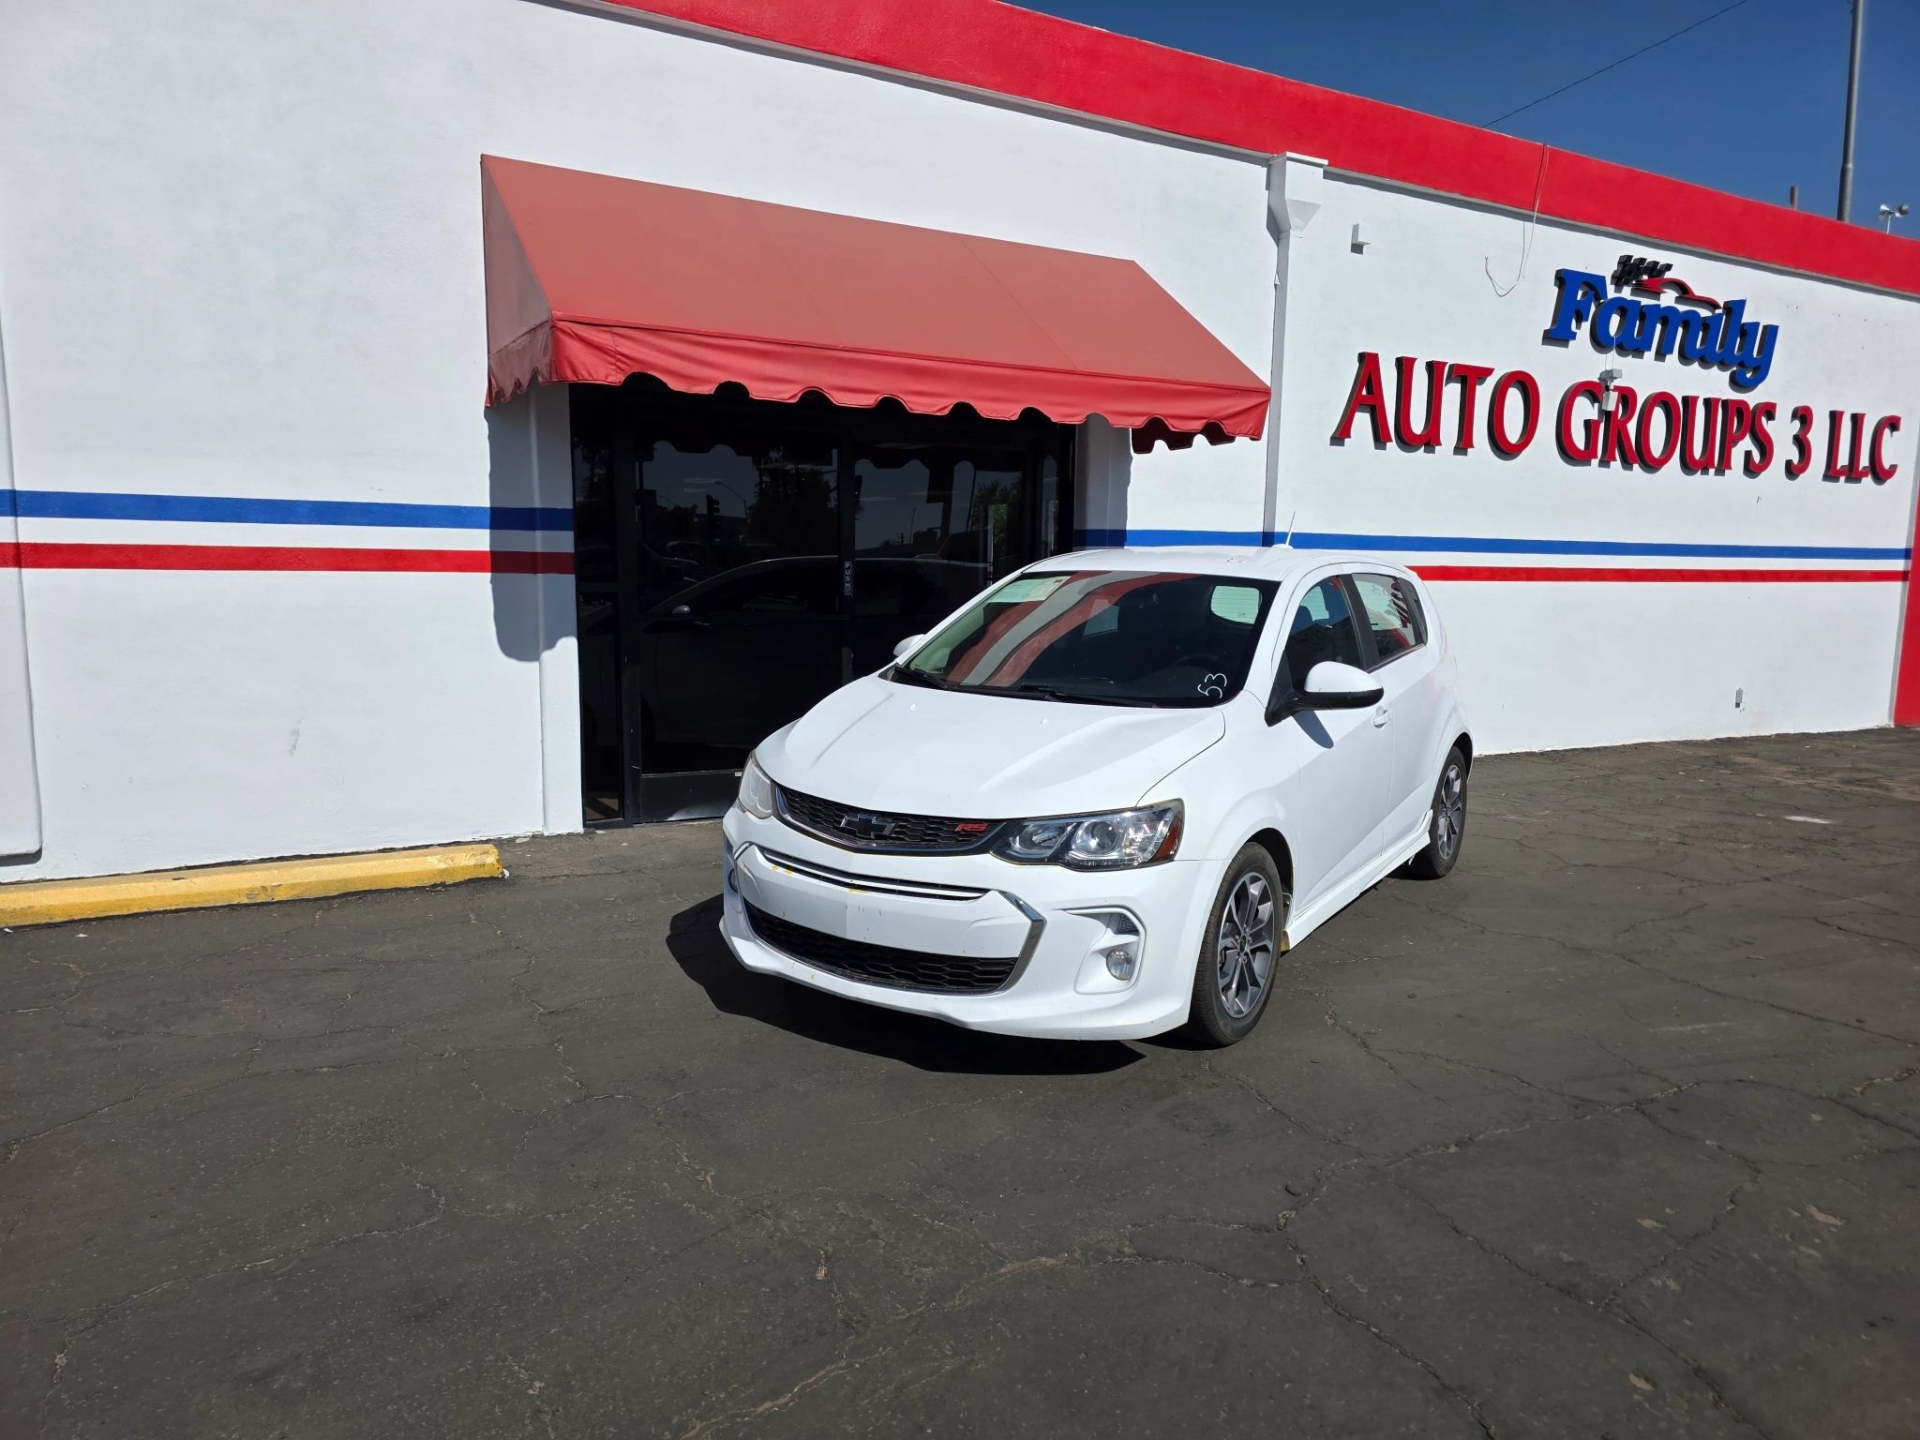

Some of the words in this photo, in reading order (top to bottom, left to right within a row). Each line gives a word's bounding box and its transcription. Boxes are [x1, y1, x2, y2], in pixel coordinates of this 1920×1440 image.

[1544, 268, 1778, 388] Family
[1332, 352, 1540, 456] AUTO
[1556, 380, 1777, 474] GROUPS
[1786, 405, 1813, 479] 3
[1825, 410, 1901, 481] LLC
[1197, 672, 1227, 699] 53
[955, 822, 987, 833] RS
